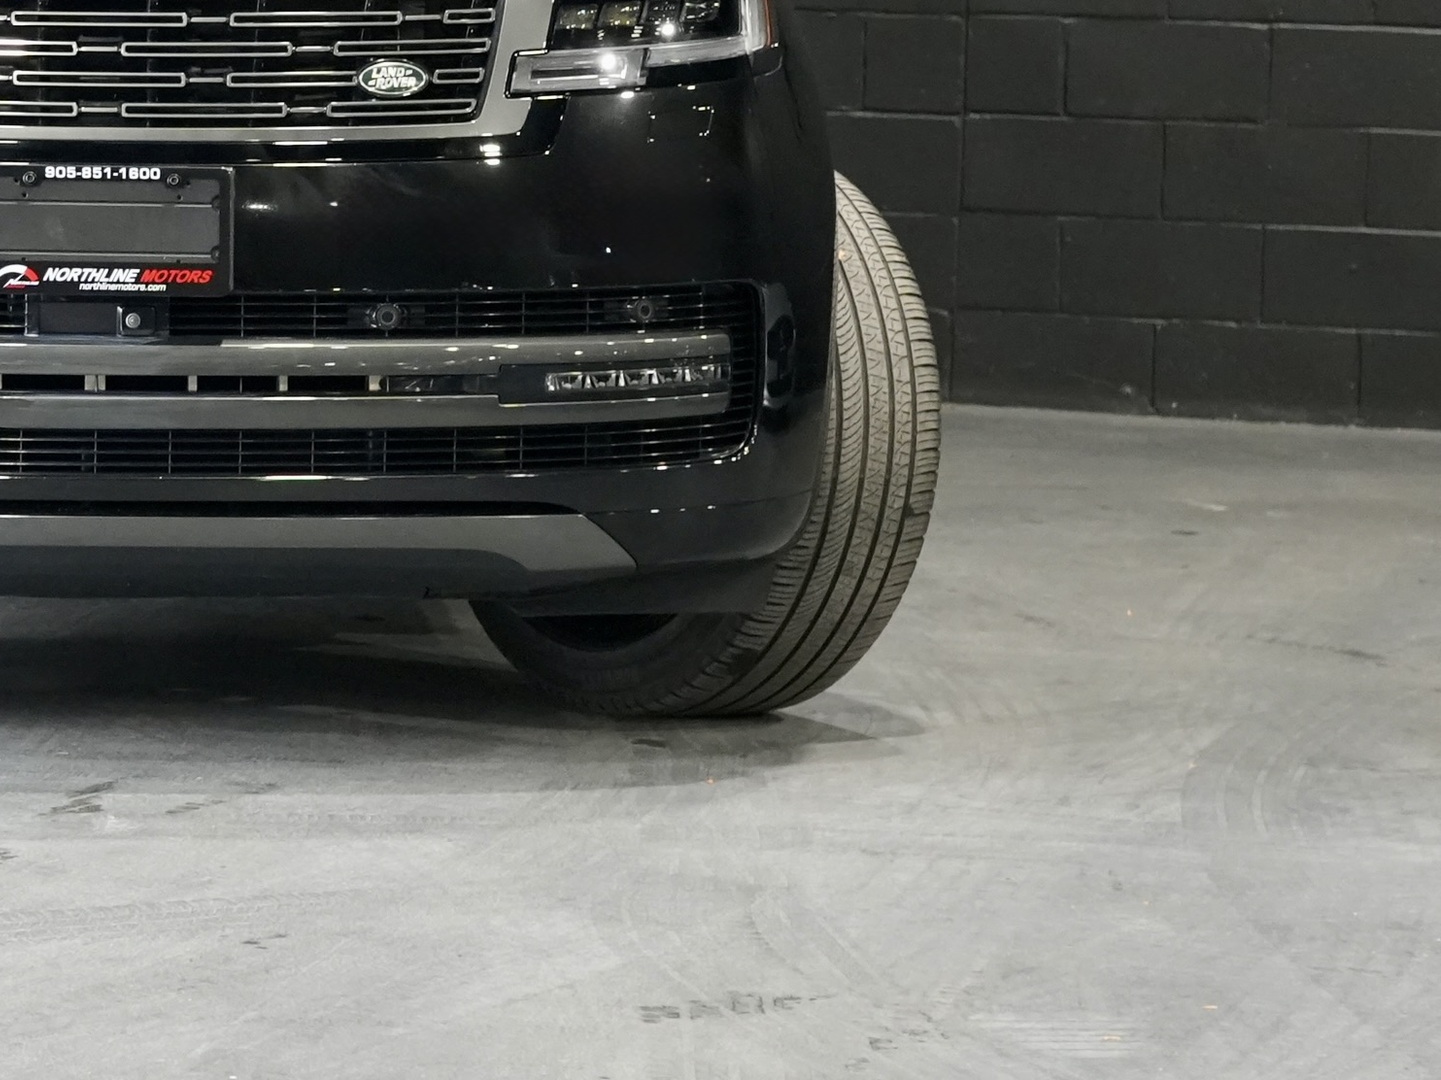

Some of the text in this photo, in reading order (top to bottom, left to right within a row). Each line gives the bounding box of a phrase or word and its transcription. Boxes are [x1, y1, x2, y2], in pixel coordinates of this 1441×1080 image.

[371, 66, 405, 78] LAND
[375, 76, 417, 89] ROVER
[45, 166, 161, 180] 905-851-1600
[43, 267, 213, 284] NORTHLINE MOTORS
[79, 282, 167, 292] northlinemotors.com
